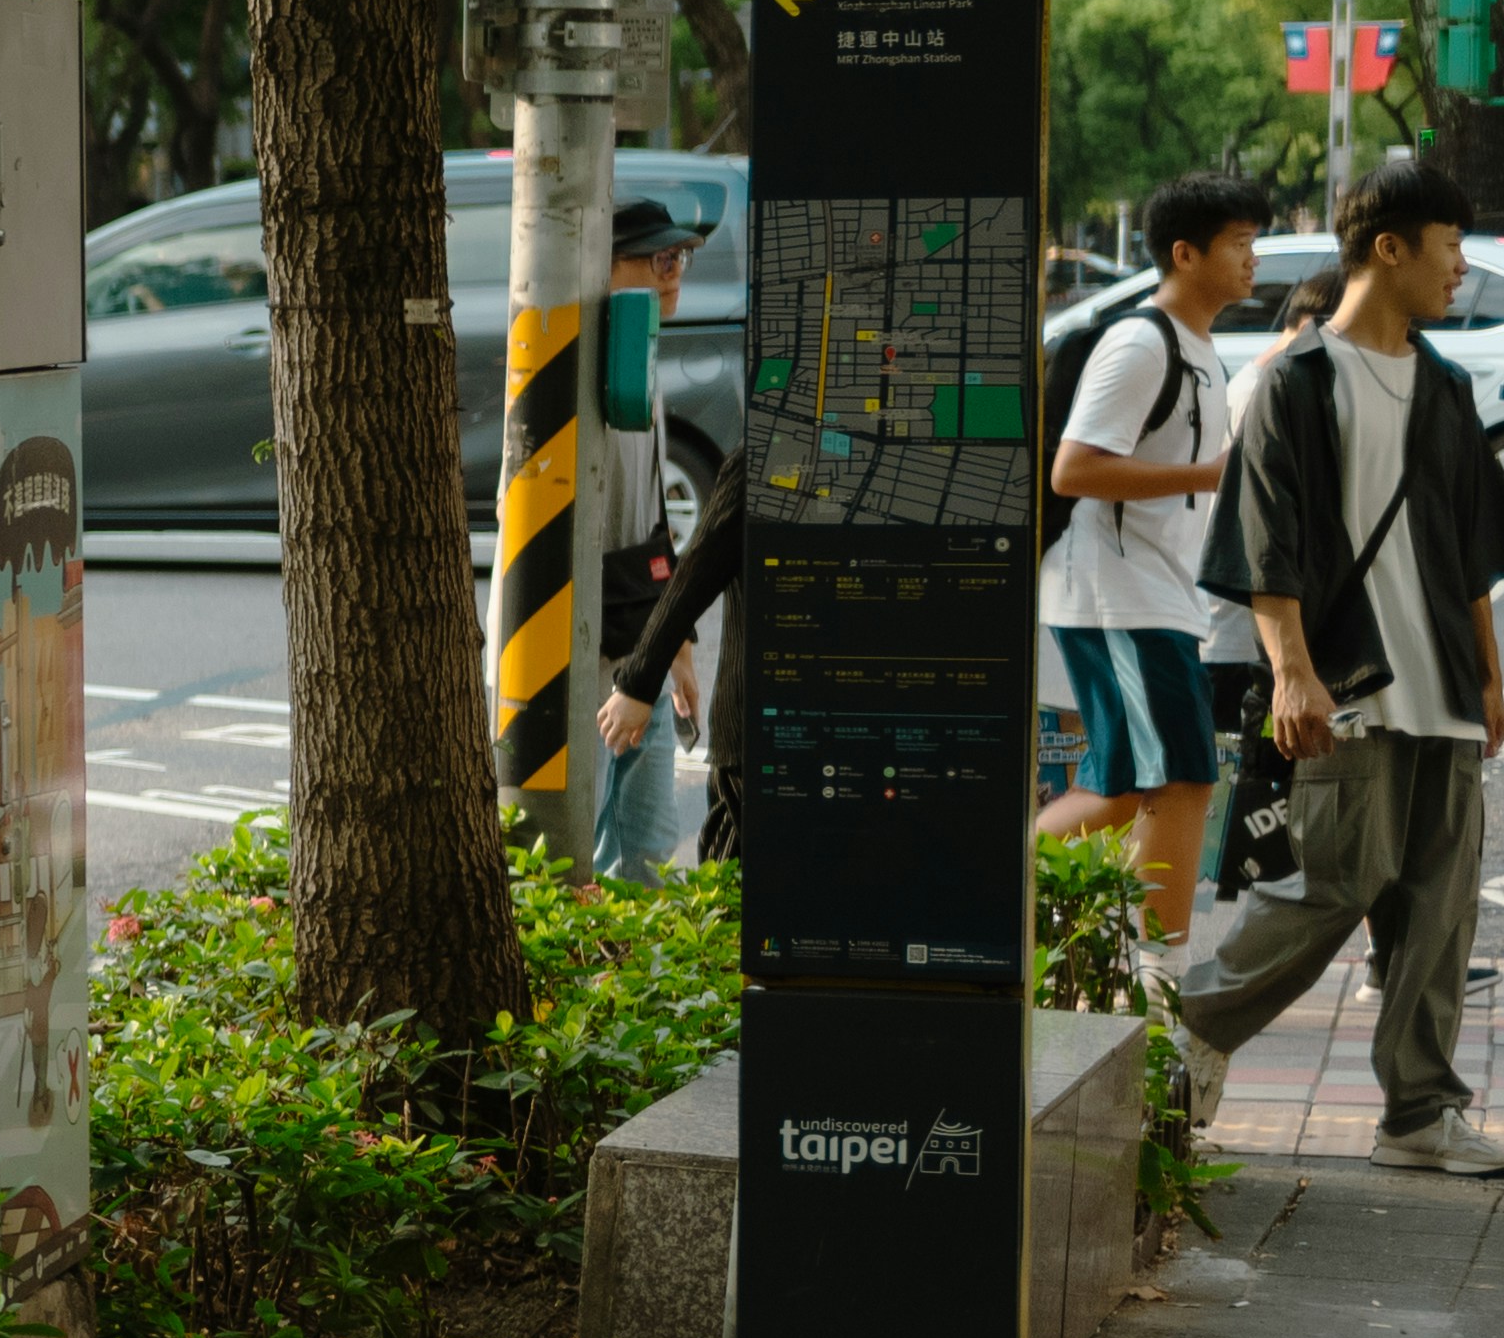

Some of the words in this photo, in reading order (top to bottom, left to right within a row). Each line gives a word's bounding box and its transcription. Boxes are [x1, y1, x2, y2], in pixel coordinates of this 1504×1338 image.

[913, 0, 946, 9] Linear
[948, 0, 974, 9] Park
[837, 29, 945, 49] 捷運中山站
[837, 55, 860, 64] MRT
[861, 54, 920, 66] Zhongshan
[923, 54, 962, 63] Station
[800, 1117, 908, 1134] undiscovered
[779, 1119, 908, 1174] taipei
